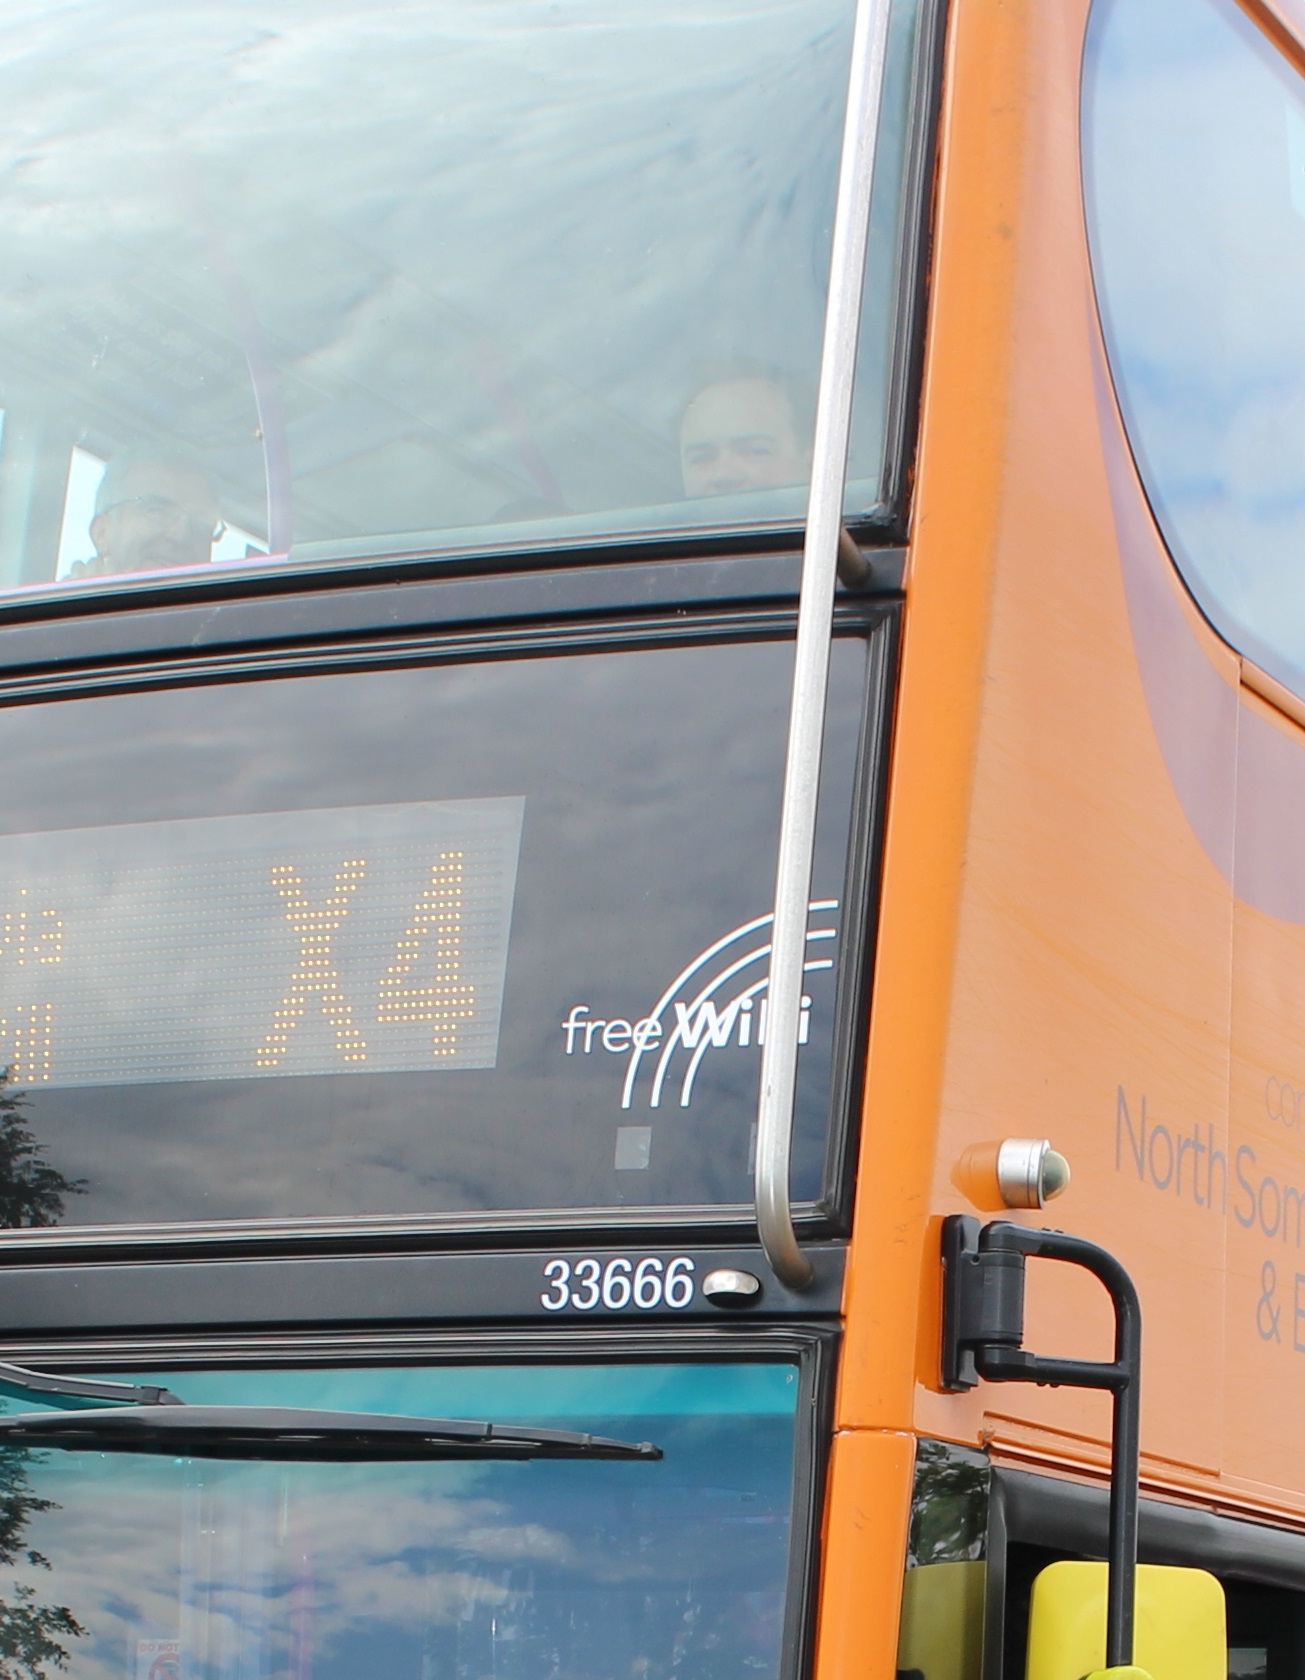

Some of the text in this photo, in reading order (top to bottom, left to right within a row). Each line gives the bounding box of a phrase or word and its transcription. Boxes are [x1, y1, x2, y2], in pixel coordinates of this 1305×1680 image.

[256, 852, 474, 1066] X4
[561, 1004, 663, 1054] free
[1115, 1084, 1228, 1215] North
[541, 1257, 695, 1310] 33666
[1256, 1260, 1282, 1344] &
